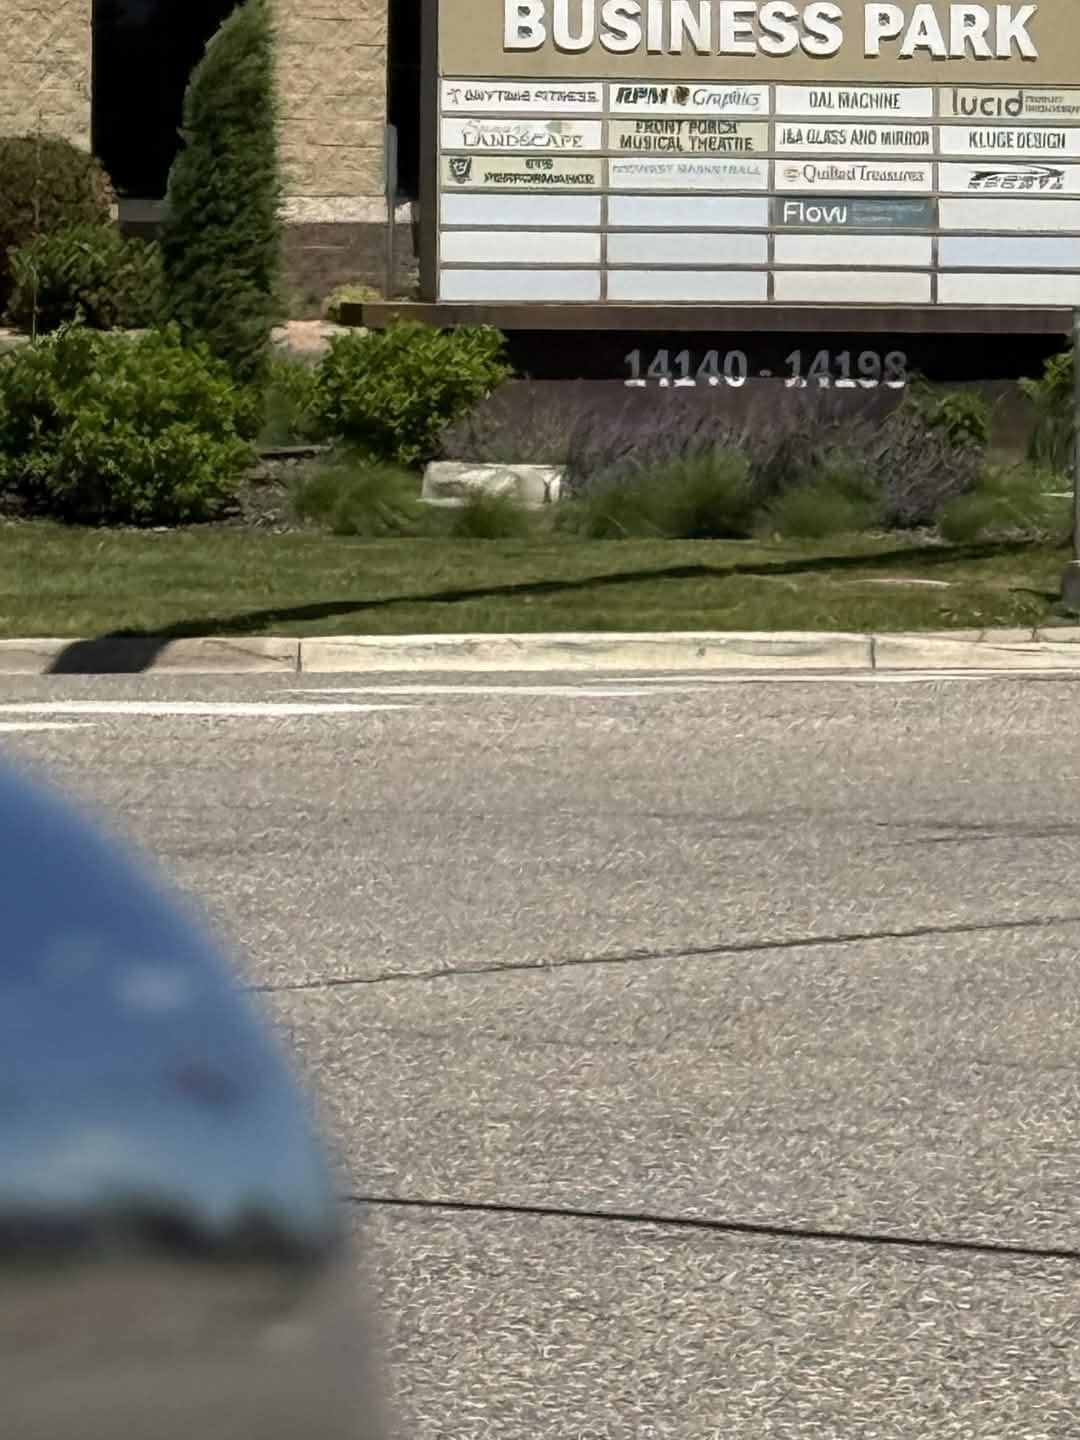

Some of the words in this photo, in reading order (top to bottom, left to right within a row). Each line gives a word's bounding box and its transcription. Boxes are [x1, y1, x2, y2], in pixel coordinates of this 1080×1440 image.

[863, 2, 1039, 60] PARK
[838, 92, 902, 110] MACHINE
[952, 88, 1024, 117] lucid
[462, 133, 584, 148] LANDSCAPE
[619, 134, 684, 151] MUSICAL
[806, 128, 847, 145] GLASS
[850, 129, 878, 146] AND
[881, 130, 930, 146] MIRROR
[968, 131, 1015, 149] KLUGE
[1016, 132, 1066, 149] DESIGN
[803, 163, 856, 183] Quilted
[856, 164, 925, 182] Treasures
[783, 200, 848, 224] Flow
[623, 348, 748, 388] 14140
[784, 349, 908, 389] 14198
